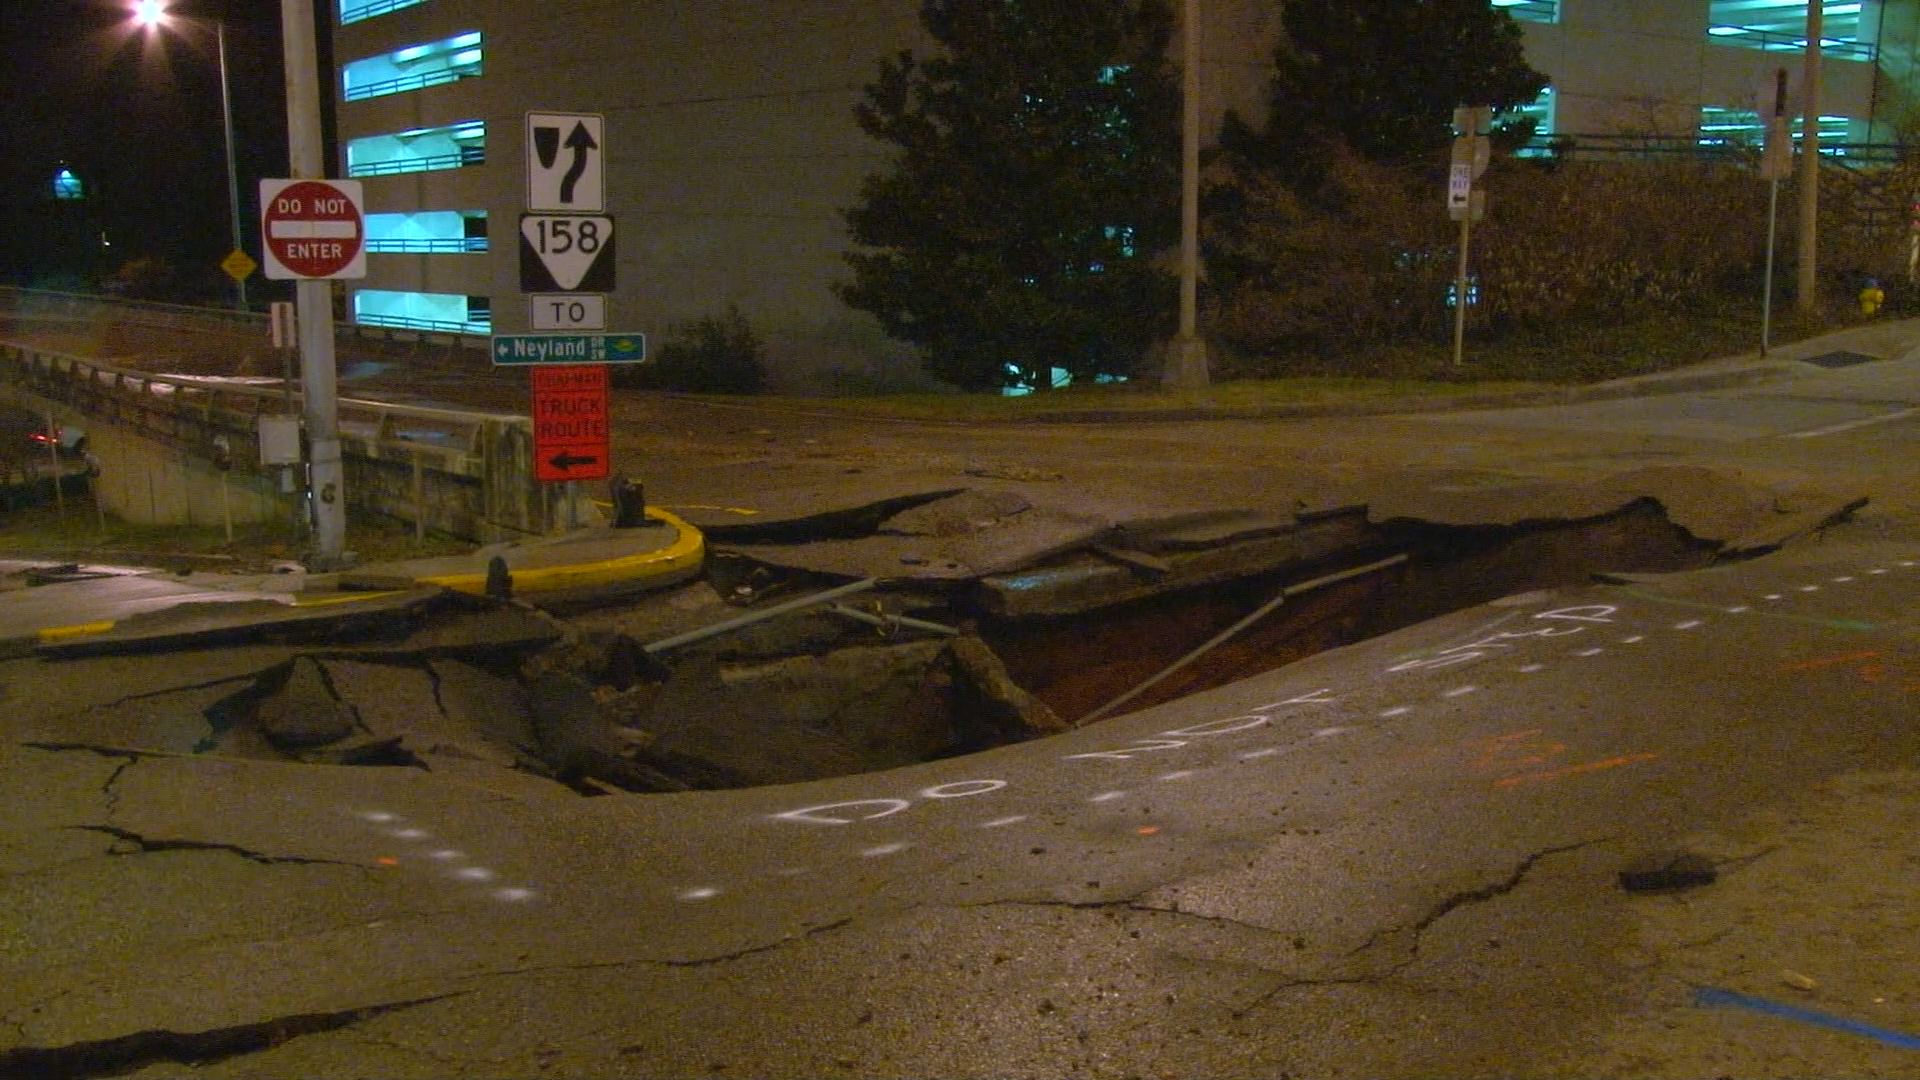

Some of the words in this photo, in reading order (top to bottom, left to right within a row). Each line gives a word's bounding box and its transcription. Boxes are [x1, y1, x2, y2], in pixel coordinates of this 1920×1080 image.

[277, 199, 301, 214] DO
[314, 199, 346, 214] NOT
[537, 220, 599, 254] 158
[287, 243, 342, 259] ENTER
[551, 302, 585, 323] TO
[514, 339, 585, 361] Neyland
[540, 399, 602, 415] TRUCK
[540, 419, 604, 437] ROUTE
